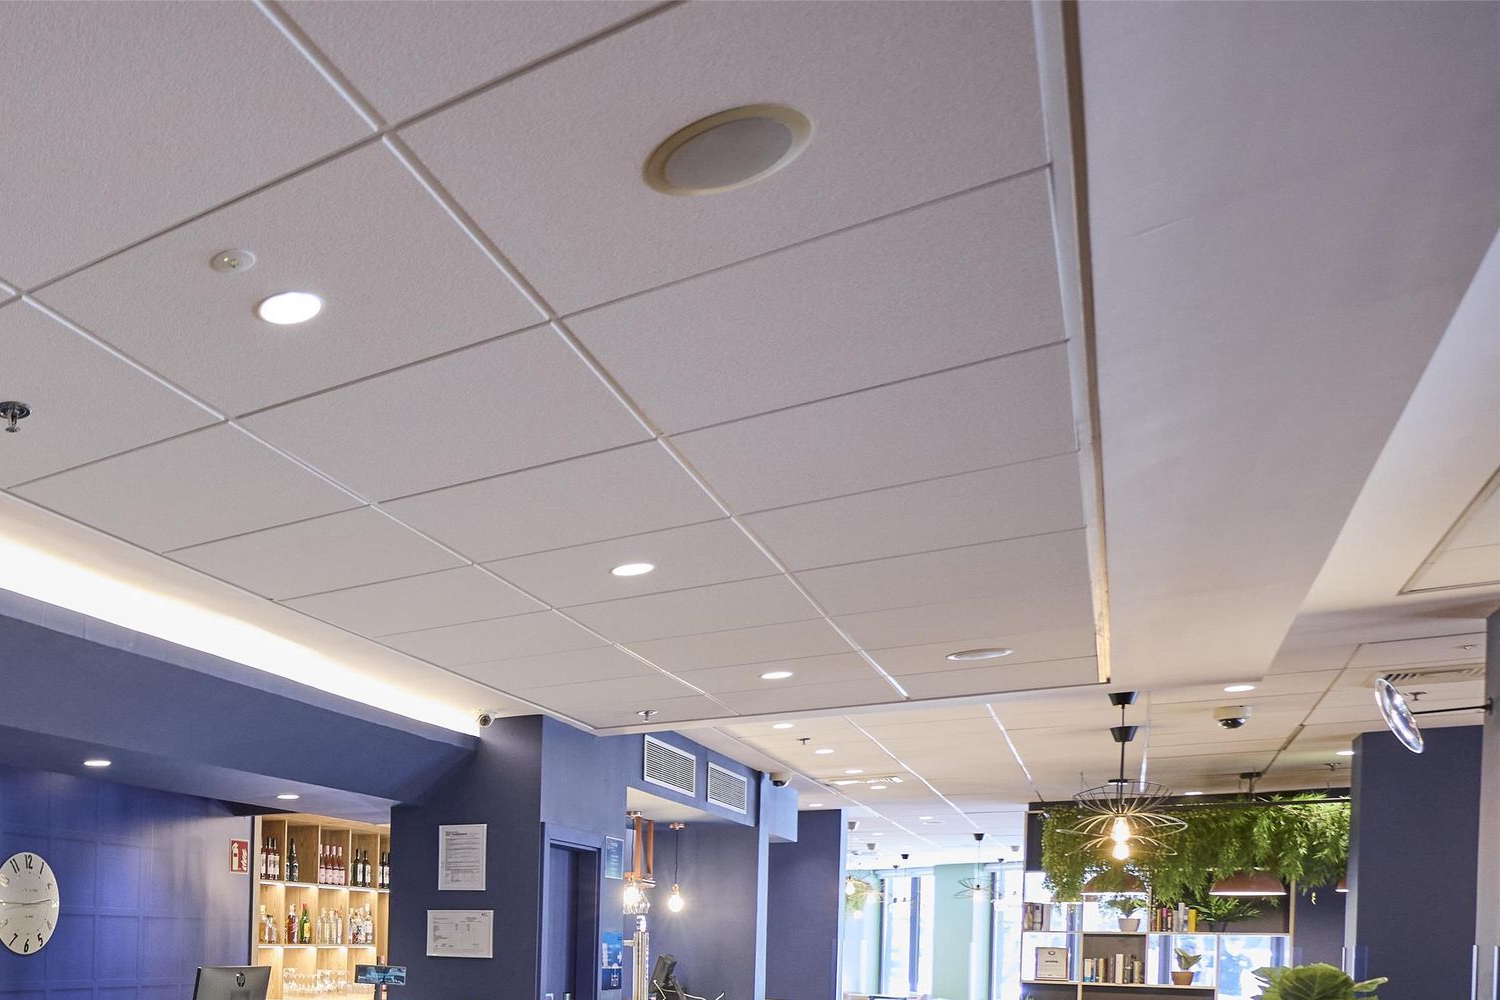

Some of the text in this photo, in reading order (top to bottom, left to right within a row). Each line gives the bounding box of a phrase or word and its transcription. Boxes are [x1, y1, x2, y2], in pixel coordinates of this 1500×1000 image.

[9, 858, 20, 874] 11
[24, 854, 33, 870] 12
[39, 861, 45, 875] 1
[8, 932, 19, 947] 7
[23, 938, 30, 953] 6
[37, 932, 44, 947] 5
